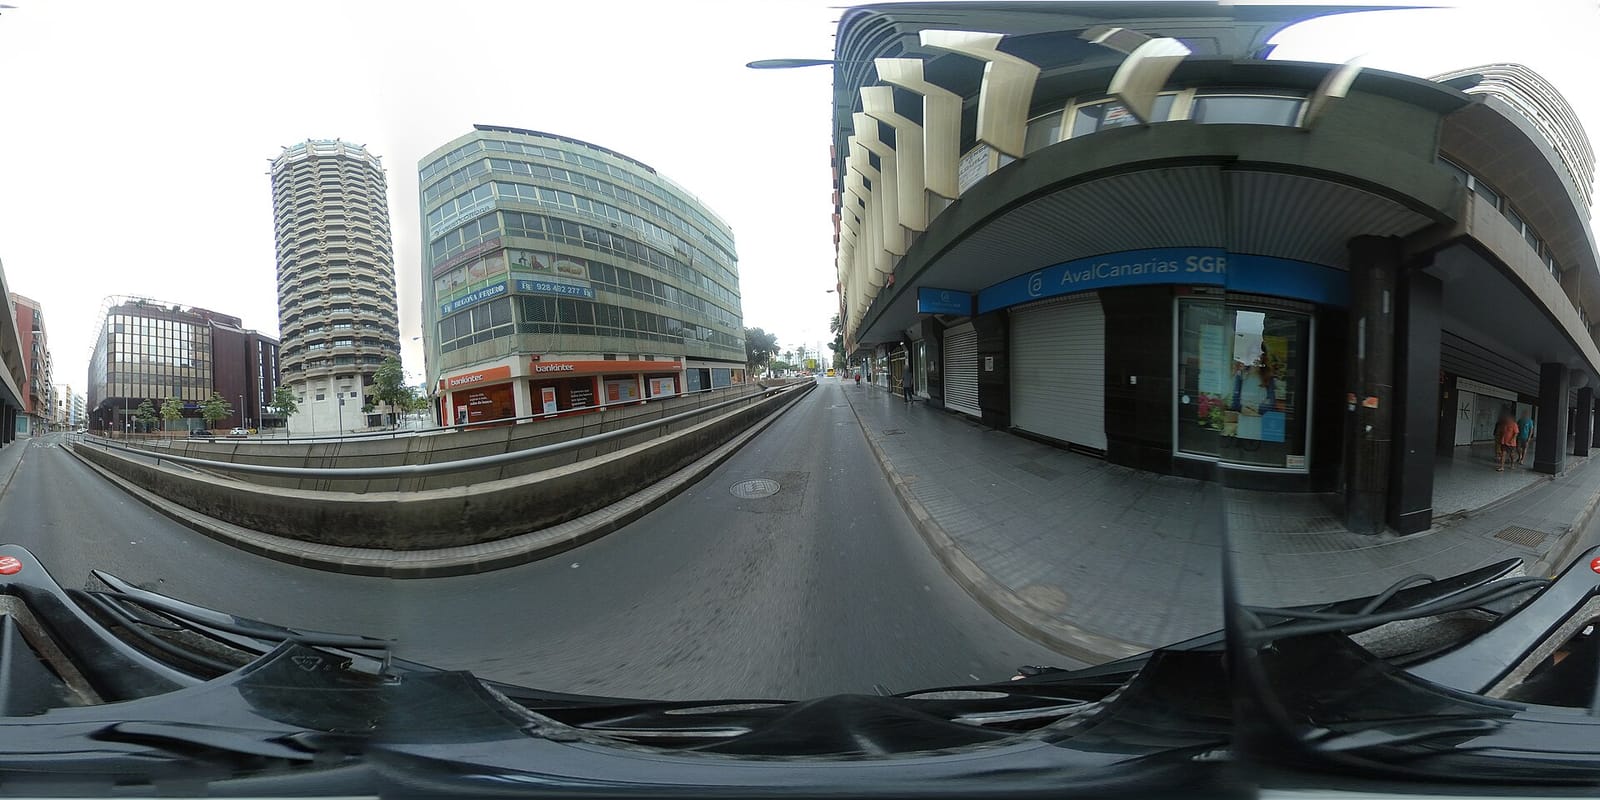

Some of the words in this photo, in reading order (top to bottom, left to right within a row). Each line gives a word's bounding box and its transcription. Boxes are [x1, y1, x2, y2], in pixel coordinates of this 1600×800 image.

[1061, 258, 1178, 286] AvalCanarias
[1184, 255, 1226, 273] SGR
[536, 283, 551, 291] 928
[535, 364, 574, 372] bankinter
[451, 374, 483, 386] bankinter
